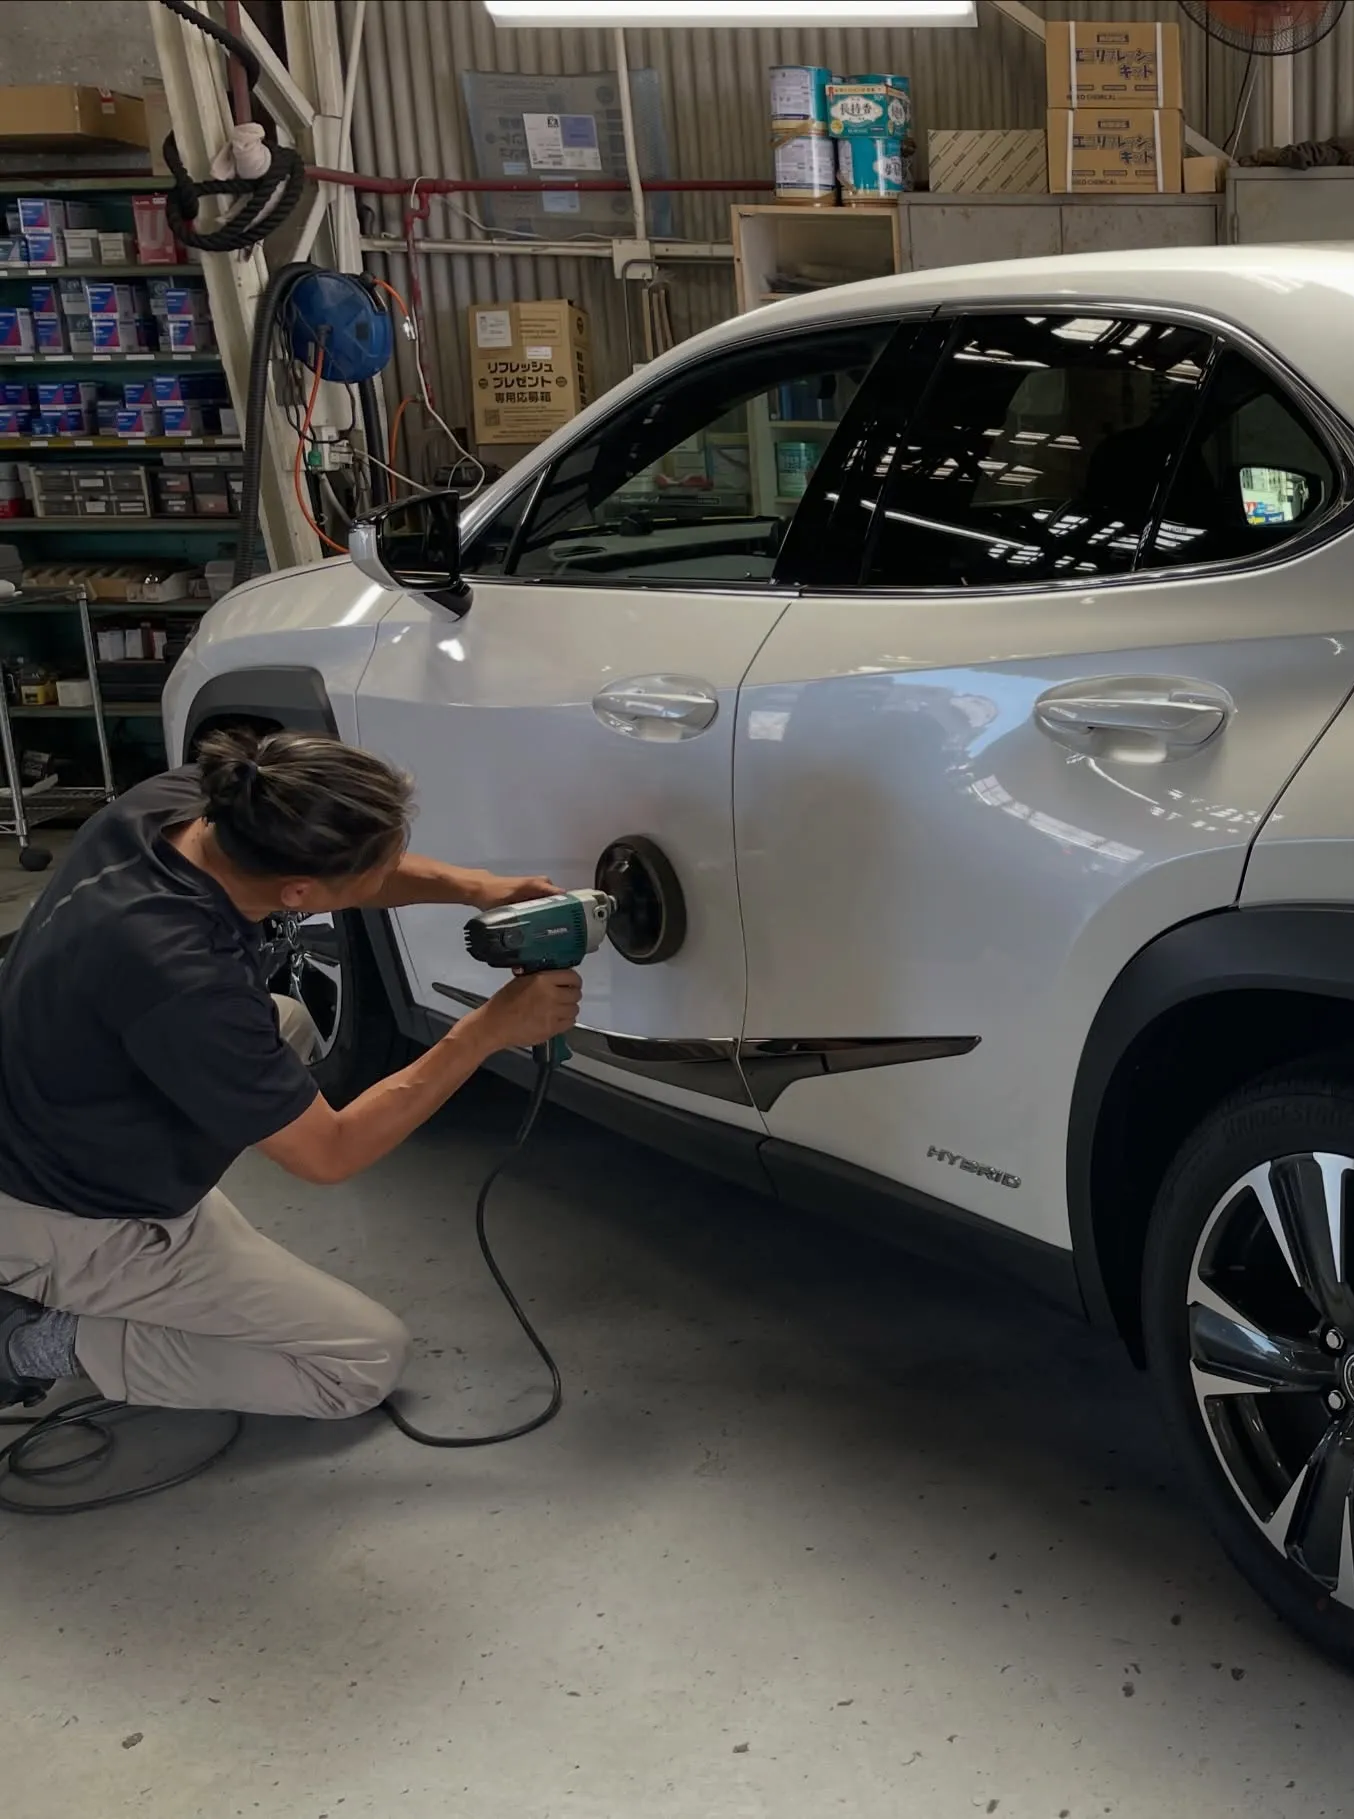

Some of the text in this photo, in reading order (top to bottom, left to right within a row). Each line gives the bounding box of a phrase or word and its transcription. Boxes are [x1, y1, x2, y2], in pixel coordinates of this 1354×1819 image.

[487, 361, 554, 374] リフレッシュ
[493, 376, 551, 389] プレゼント
[495, 391, 551, 404] 専用応募箱
[926, 1145, 1021, 1188] HYBRID
